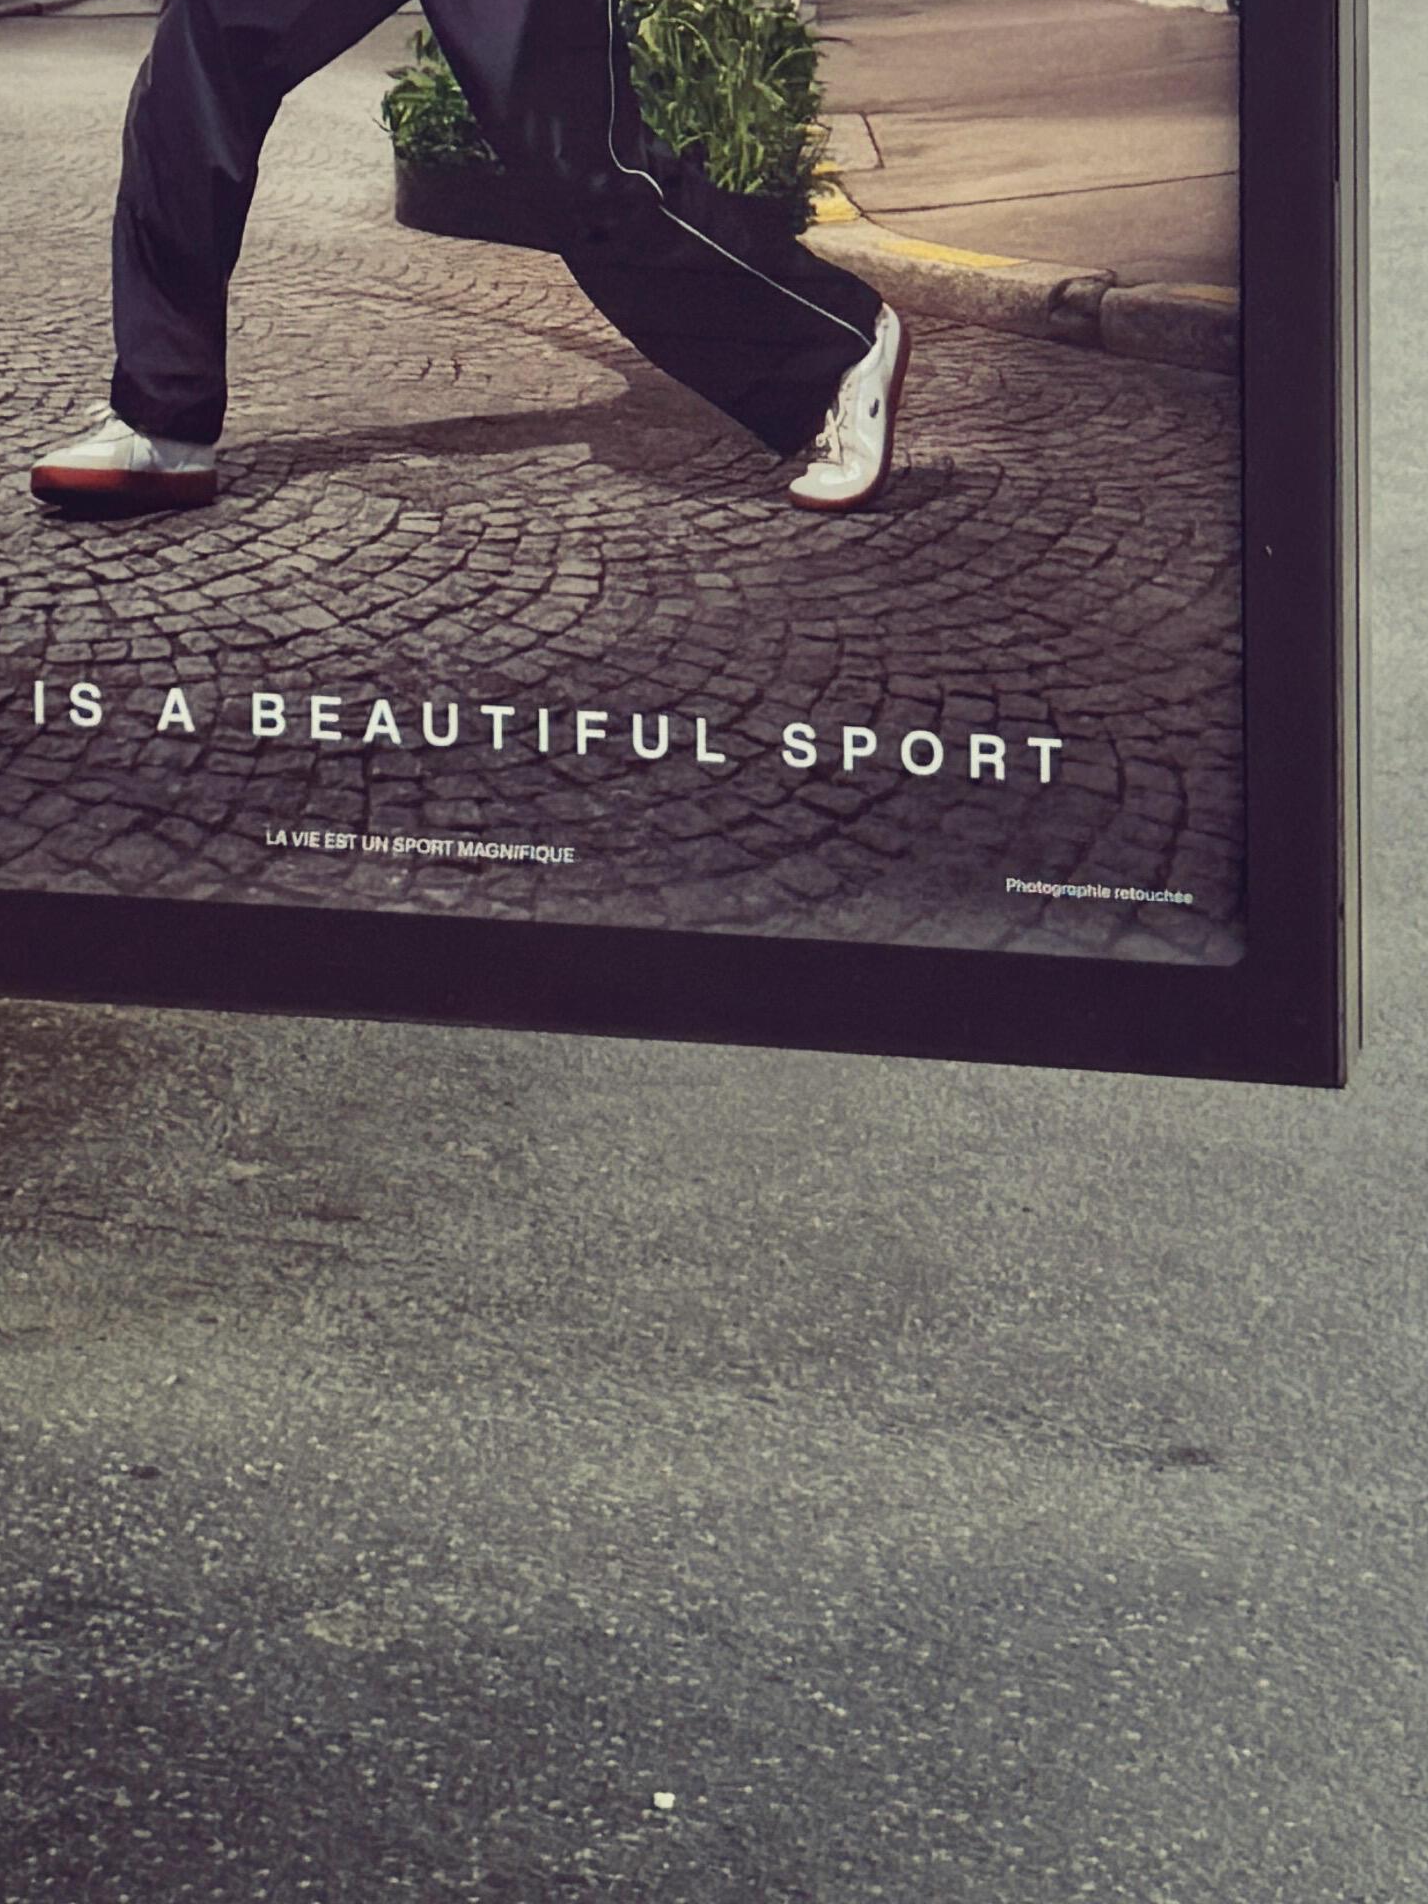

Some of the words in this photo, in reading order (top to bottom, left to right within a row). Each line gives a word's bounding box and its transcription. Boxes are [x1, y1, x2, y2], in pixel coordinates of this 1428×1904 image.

[34, 680, 102, 727] IS
[157, 687, 195, 732] A
[252, 692, 727, 763] BEAUTIFUL
[782, 722, 1064, 784] SPORT
[265, 829, 288, 847] LA
[291, 830, 321, 849] VIE
[324, 832, 358, 851] EST
[361, 835, 390, 854] UN
[392, 837, 455, 859] SPORT
[456, 841, 576, 865] MAGNIFIQUE
[1005, 877, 1112, 900] Photographie
